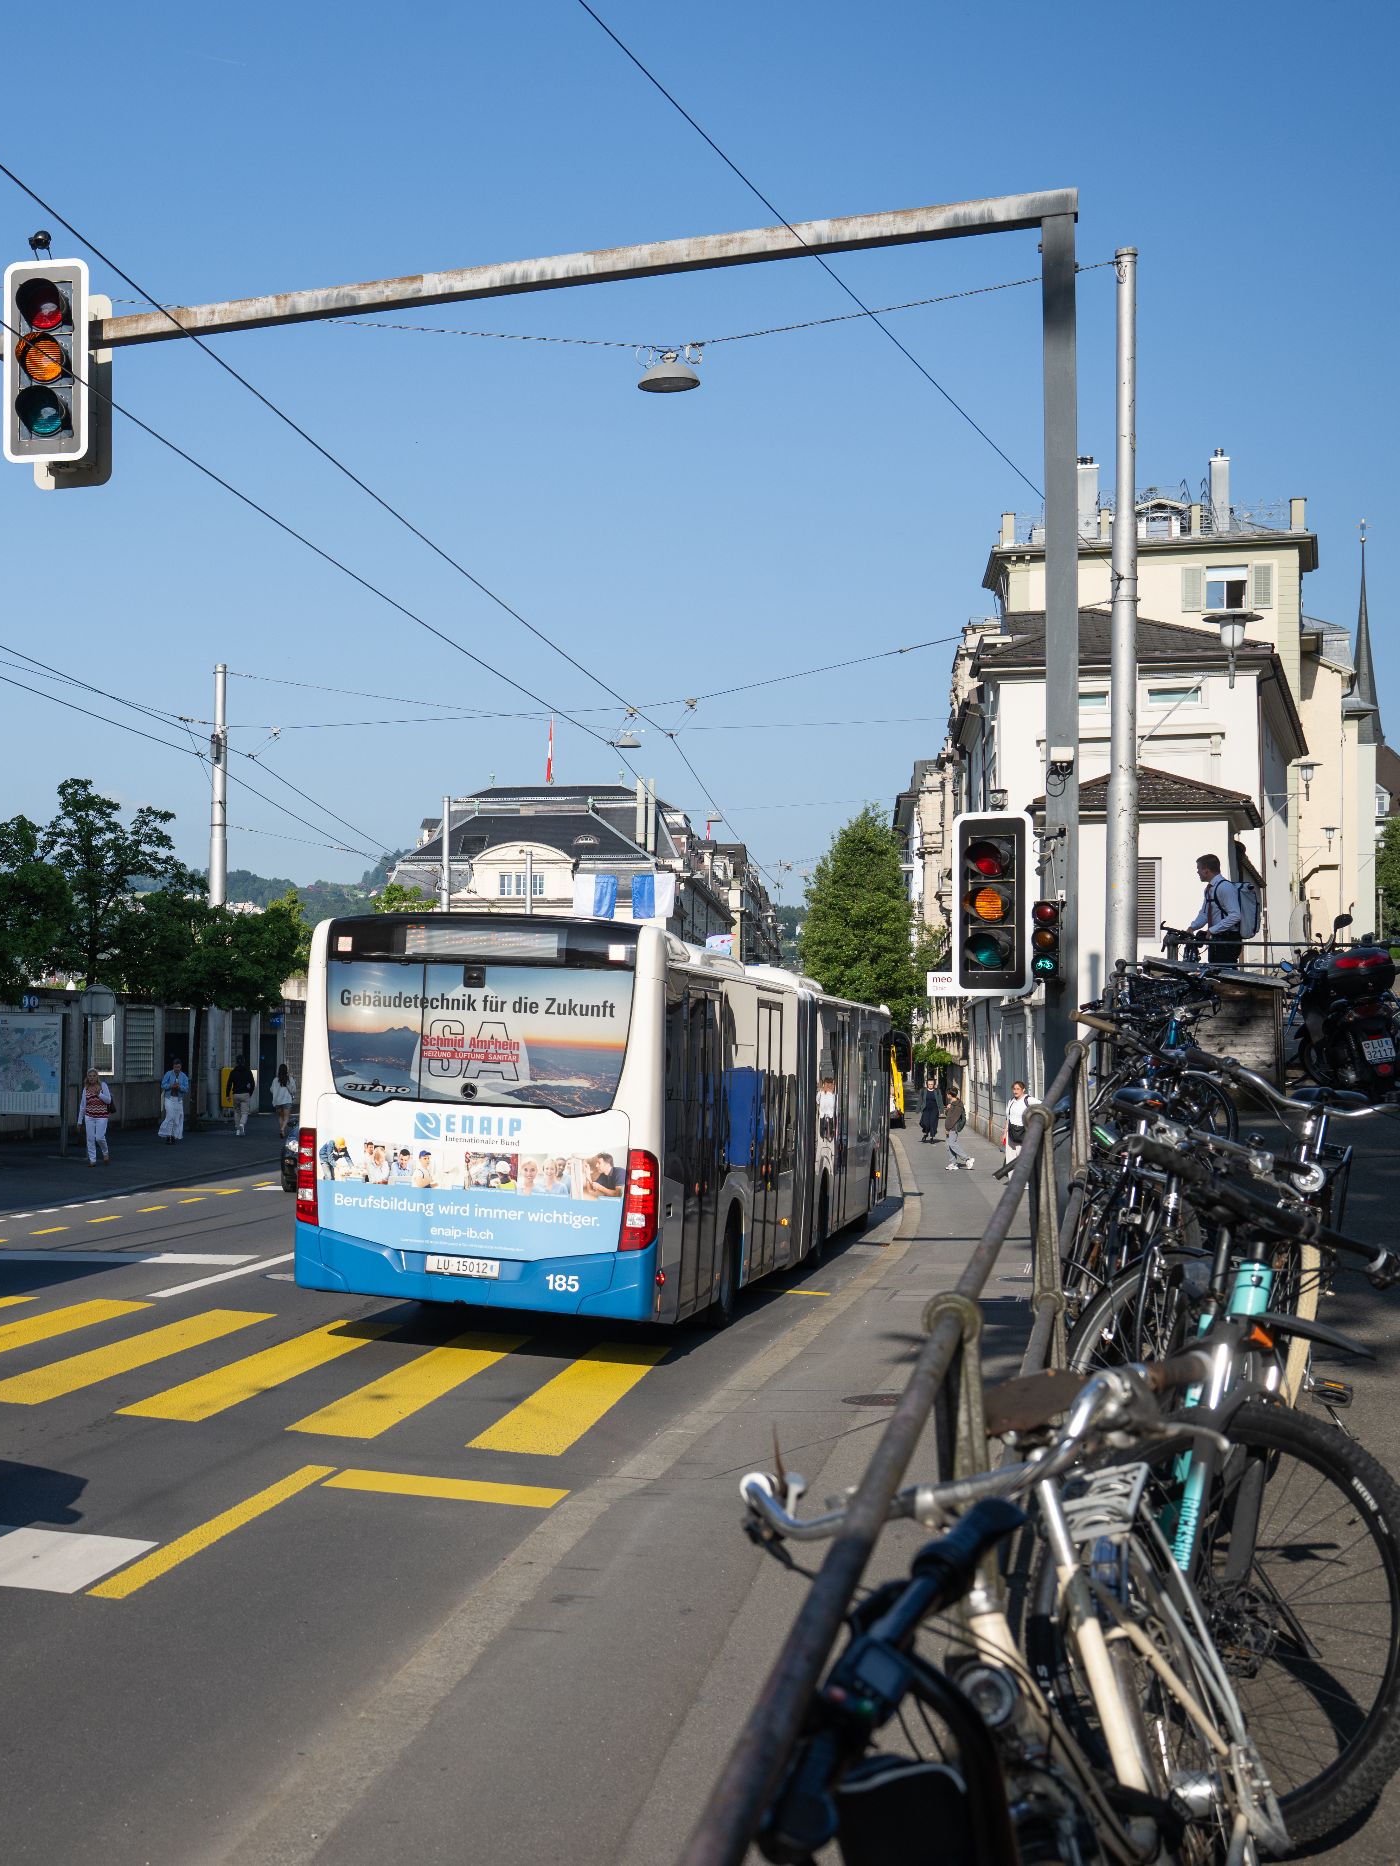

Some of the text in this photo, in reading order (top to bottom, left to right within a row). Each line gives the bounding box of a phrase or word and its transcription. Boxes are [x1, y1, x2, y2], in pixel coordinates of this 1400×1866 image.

[340, 988, 616, 1018] Gebäudetechnik für die Zukunft
[422, 1034, 520, 1051] Schmid Amrhein
[344, 1083, 411, 1093] CITARO
[445, 1135, 520, 1147] Internationaler Bund
[333, 1193, 600, 1230] Berufsbildung wird immer wichtiger.
[430, 1225, 494, 1240] enaip-ib.ch
[545, 1273, 580, 1293] 185
